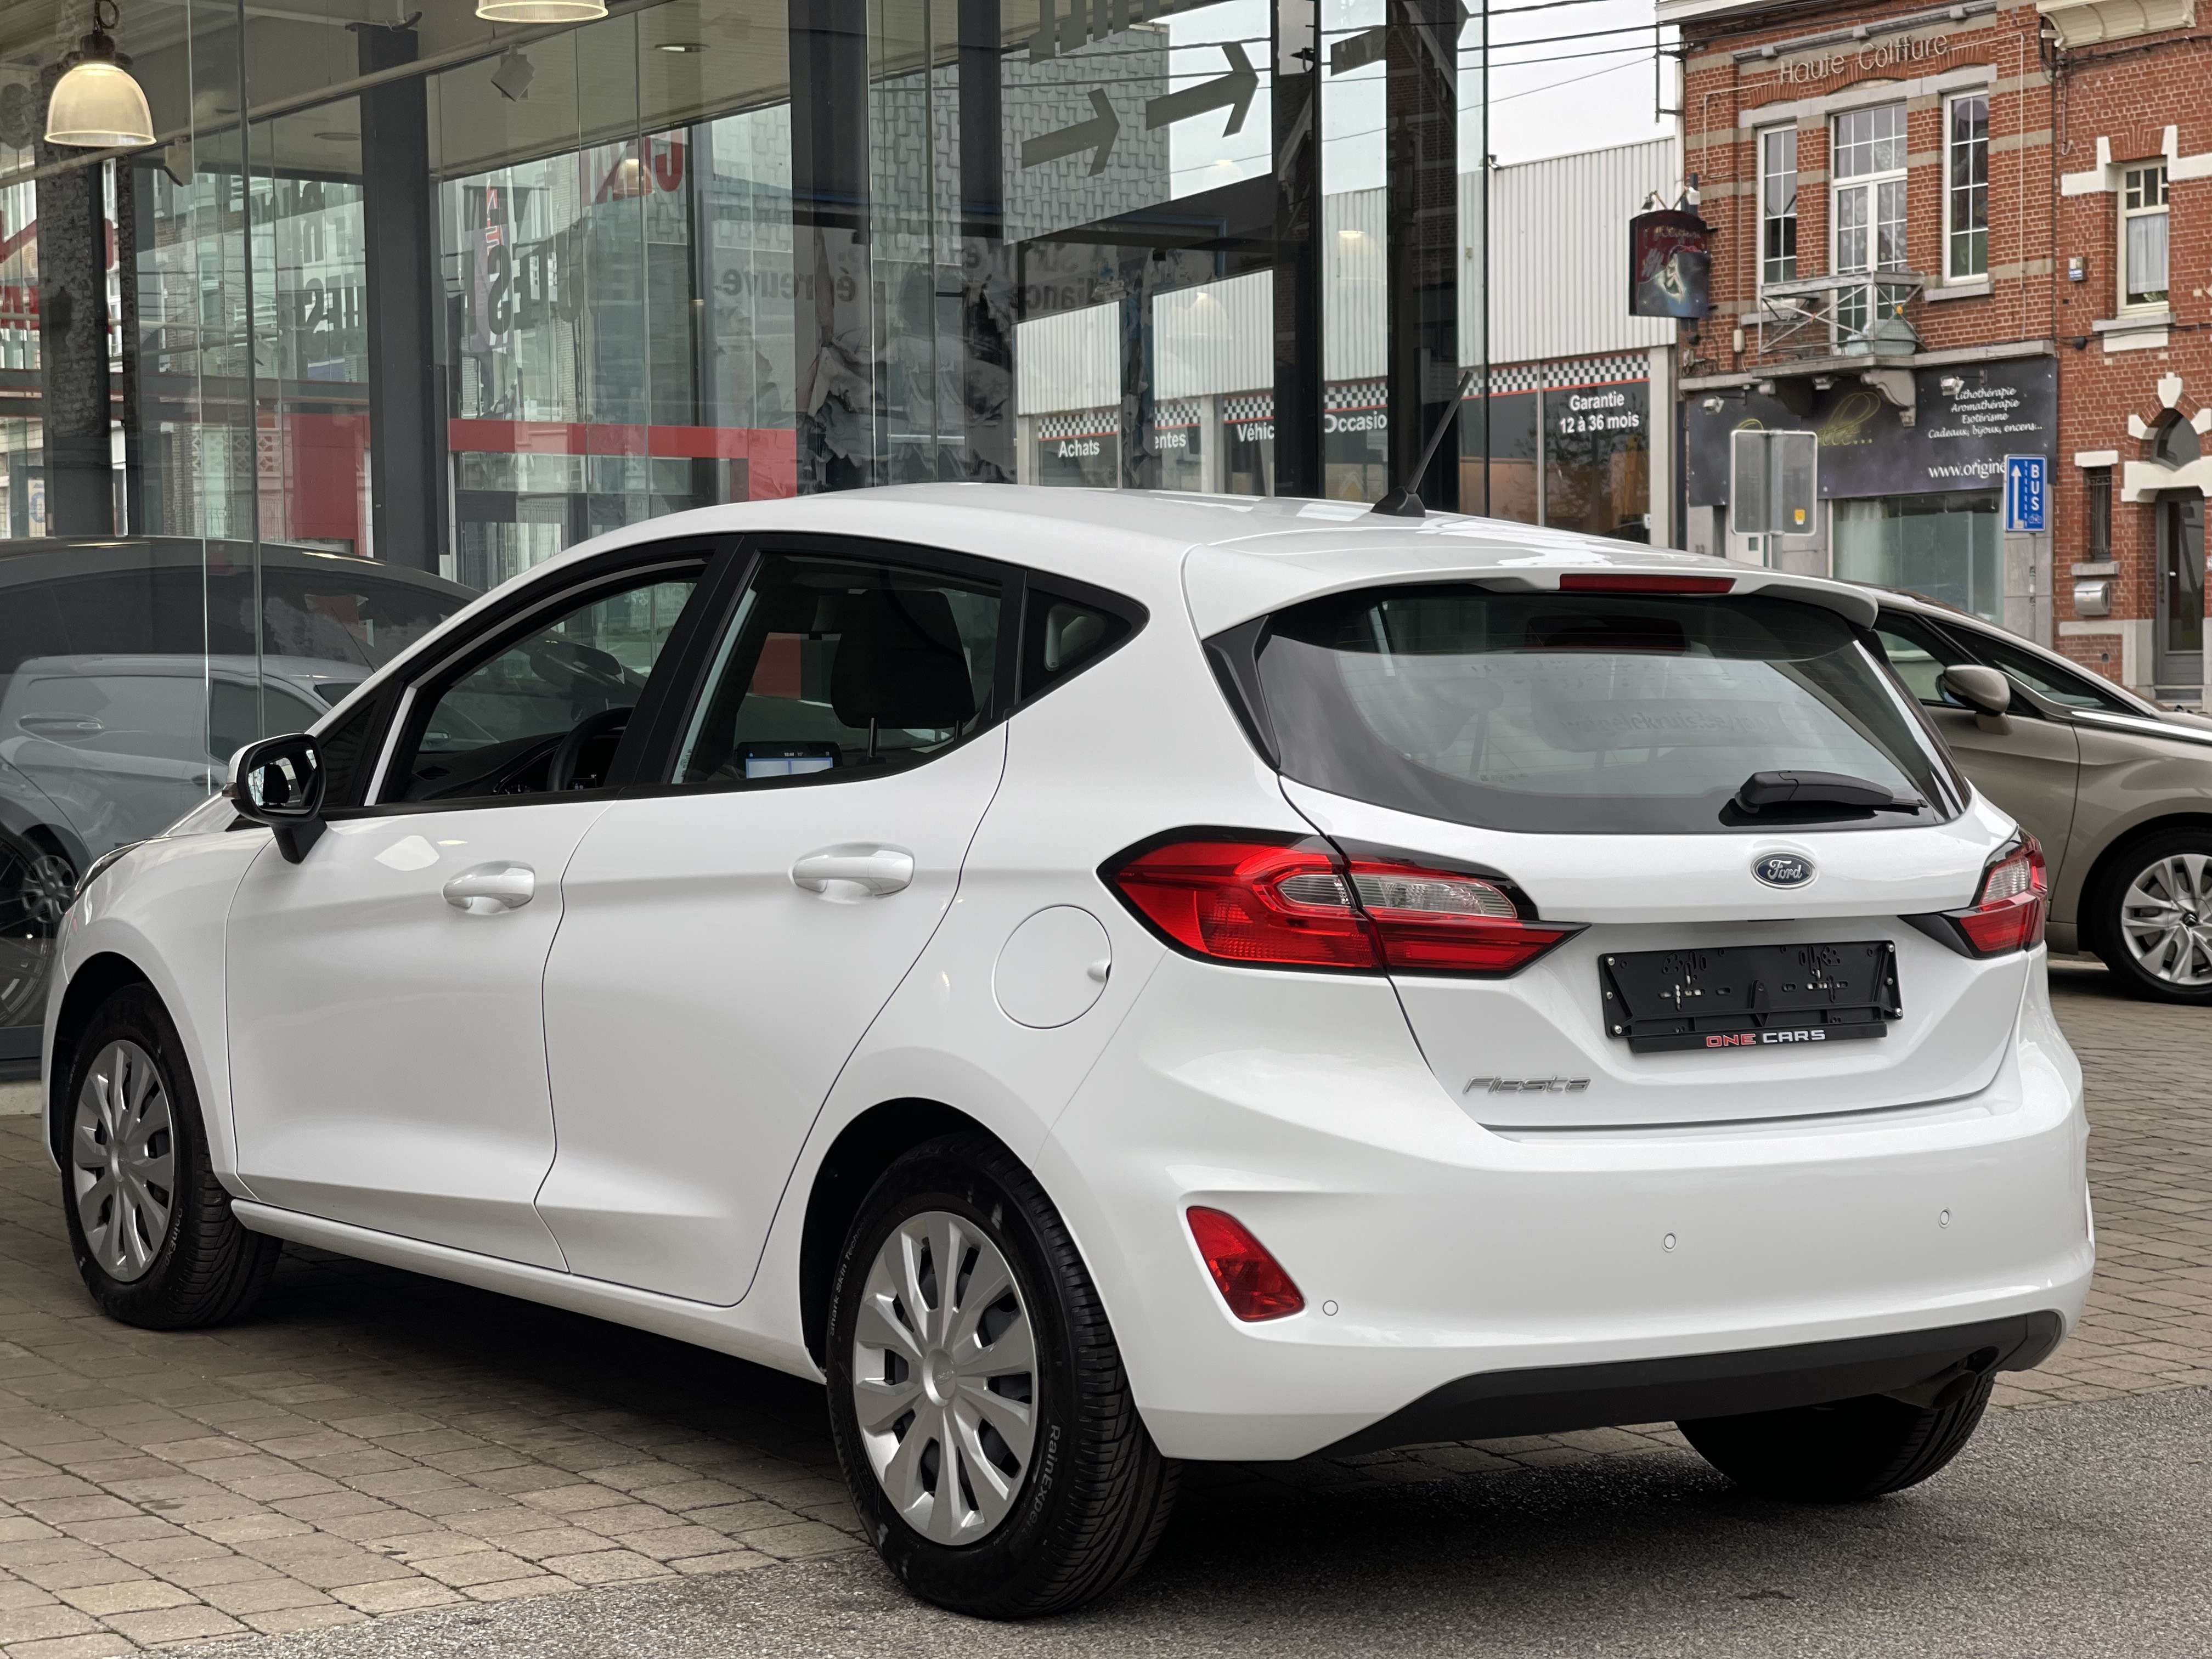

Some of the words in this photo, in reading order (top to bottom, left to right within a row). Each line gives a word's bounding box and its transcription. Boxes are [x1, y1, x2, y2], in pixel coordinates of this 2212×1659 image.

[1780, 52, 1844, 85] Haute
[1859, 35, 1947, 70] Coiffure
[1570, 391, 1624, 411] Garantie
[1955, 386, 2017, 400] Lithothérapie
[1950, 399, 2020, 413] Aromathérapie
[1237, 421, 1274, 443] Véhic
[1324, 411, 1387, 433] Occasio
[1560, 416, 1575, 434] 12
[1577, 416, 1585, 432] à
[1588, 414, 1604, 431] 36
[1607, 411, 1639, 430] mois
[1962, 413, 2009, 424] Esotérisme
[1928, 426, 1970, 438] Cadeaux,
[1972, 425, 2002, 438] bijoux,
[1058, 439, 1100, 458] Achats
[1154, 432, 1187, 449] entes
[1928, 458, 2006, 479] www.origine
[2031, 464, 2040, 511] BUS
[1767, 859, 1803, 879] Ford
[1706, 1033, 1757, 1048] ONE
[1763, 1029, 1826, 1043] CARS
[1462, 1075, 1591, 1094] Fiesta
